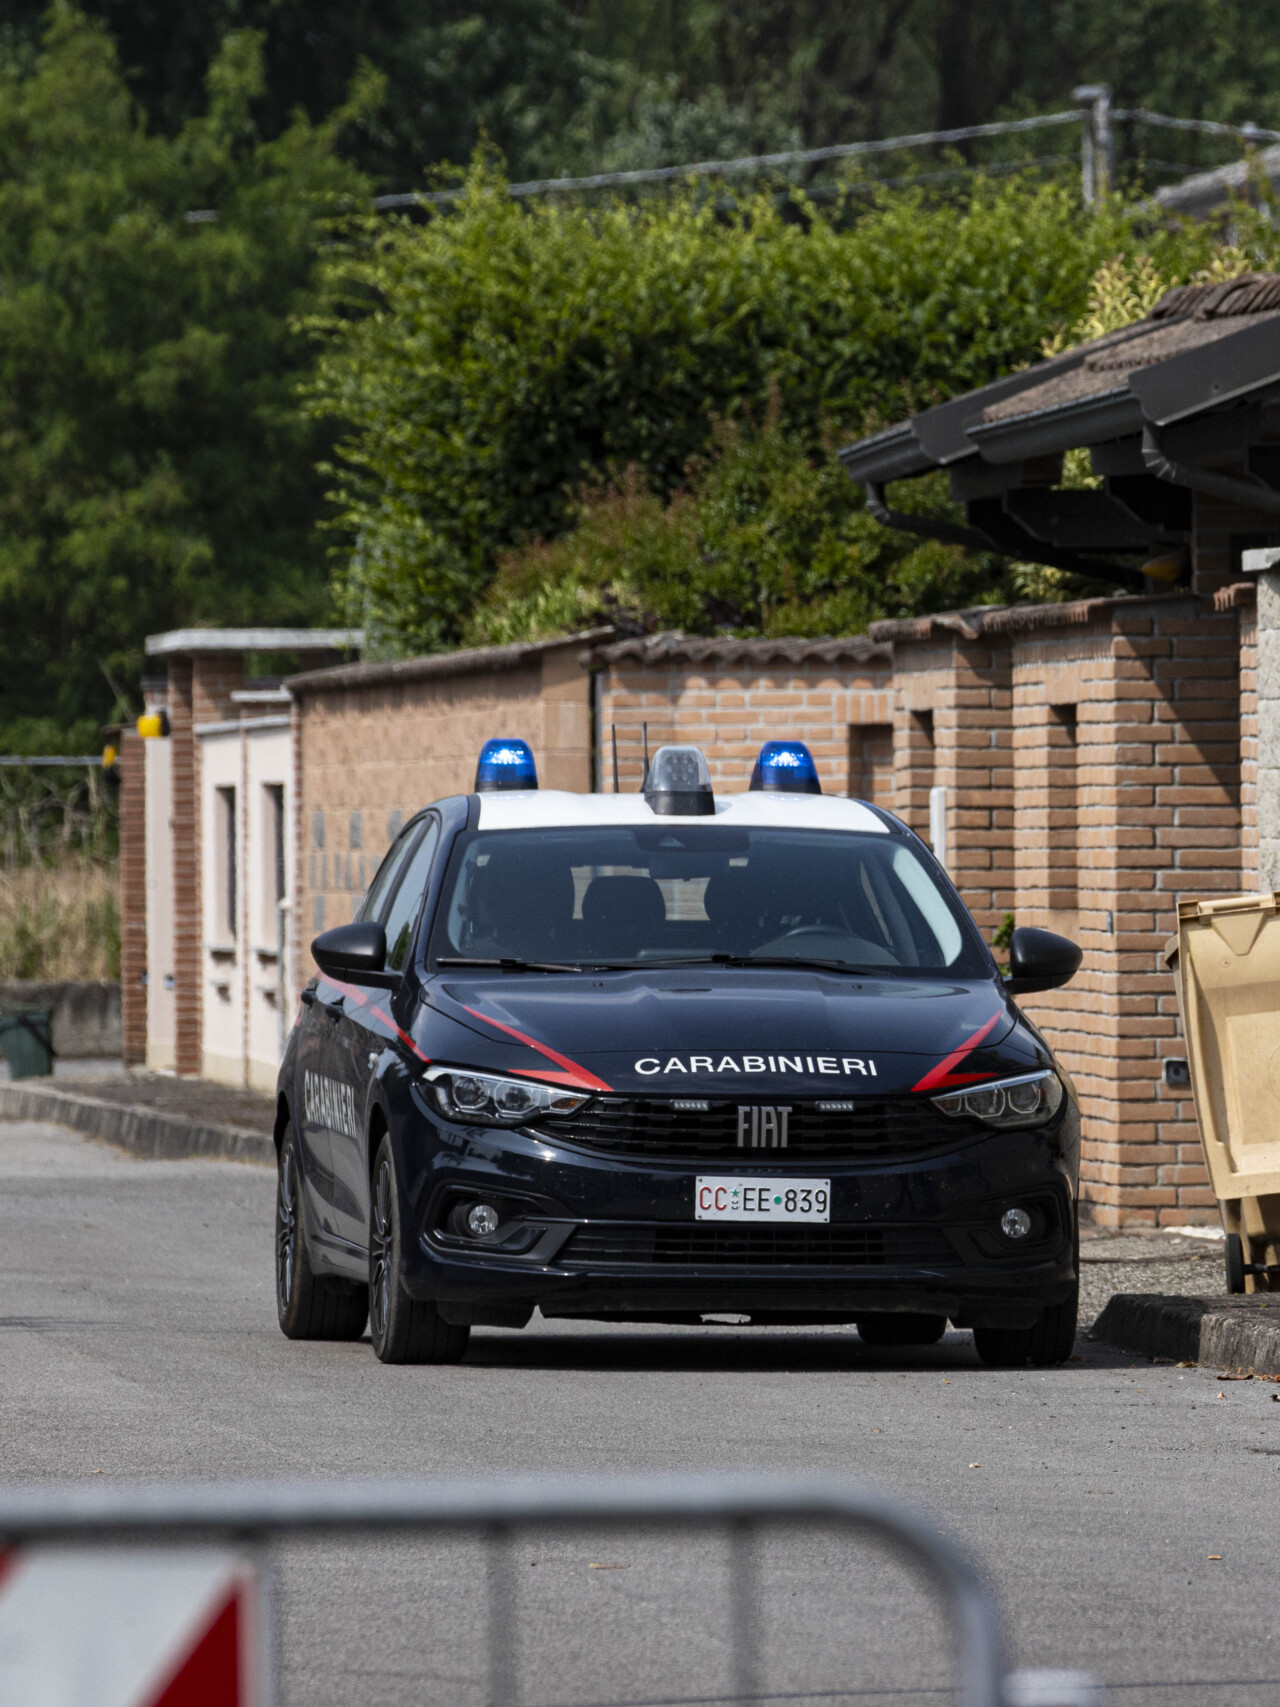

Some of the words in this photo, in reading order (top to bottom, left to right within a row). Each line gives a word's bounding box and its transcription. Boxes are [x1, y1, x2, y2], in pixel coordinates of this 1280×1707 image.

[634, 1056, 878, 1076] CARABINIERI
[304, 1069, 357, 1139] CARABINIERI
[737, 1105, 793, 1148] FIAT
